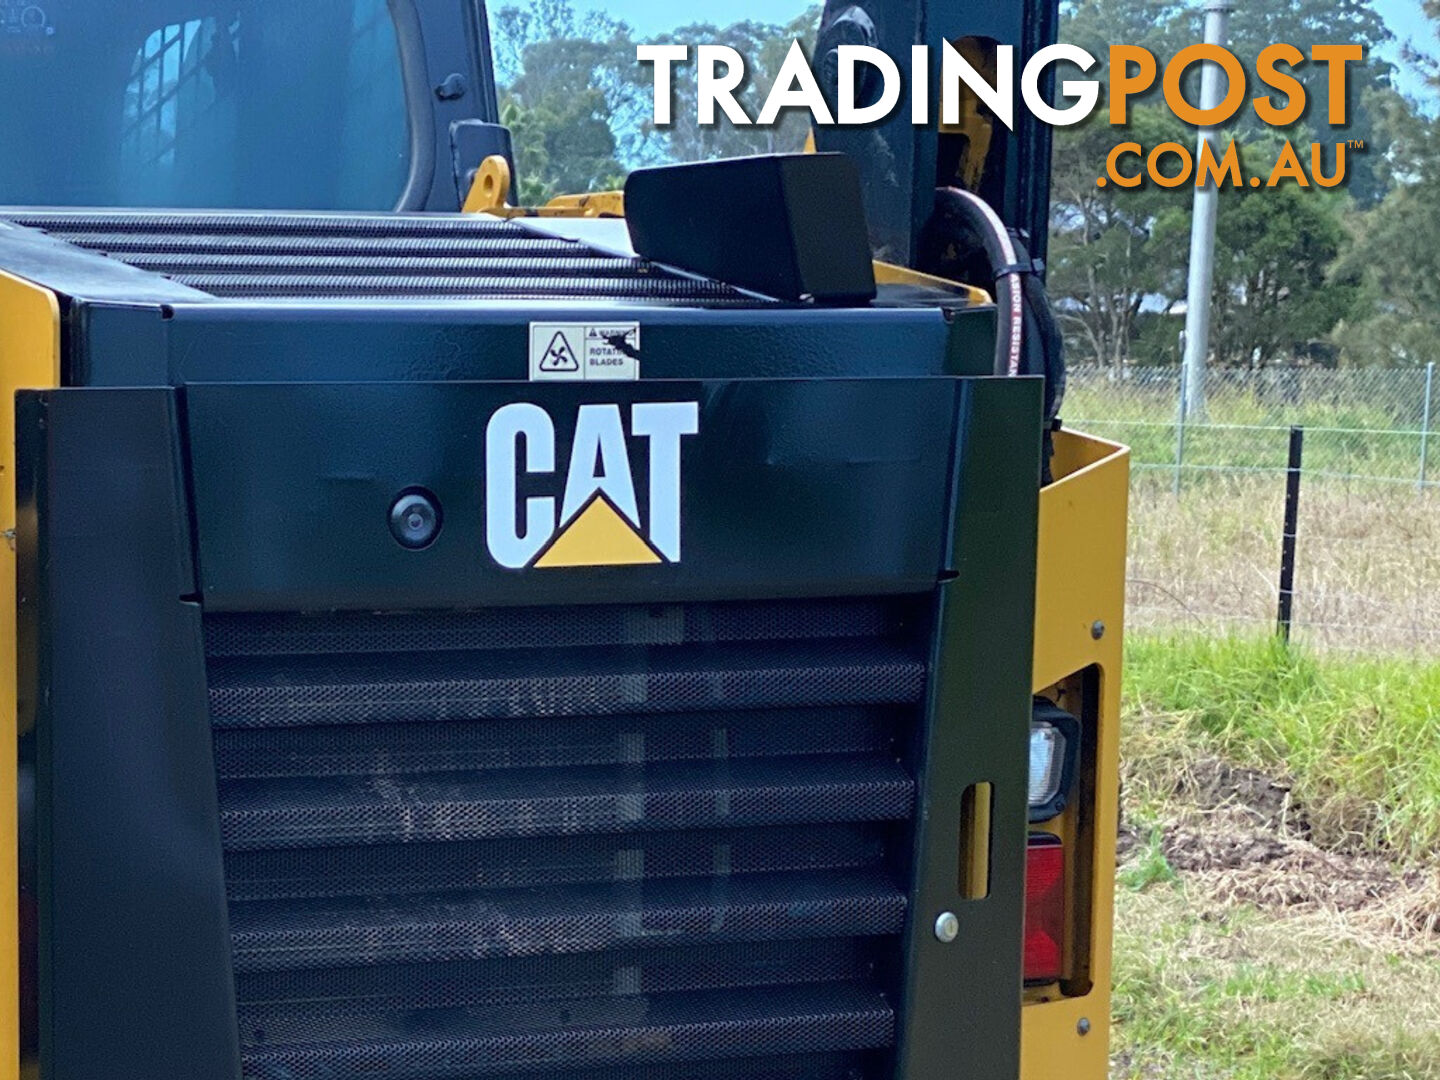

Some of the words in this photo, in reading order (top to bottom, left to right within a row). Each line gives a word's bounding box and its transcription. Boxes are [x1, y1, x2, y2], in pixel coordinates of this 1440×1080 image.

[590, 358, 624, 366] BLADES
[1008, 316, 1022, 377] RESISTAN
[486, 401, 699, 569] CAT
